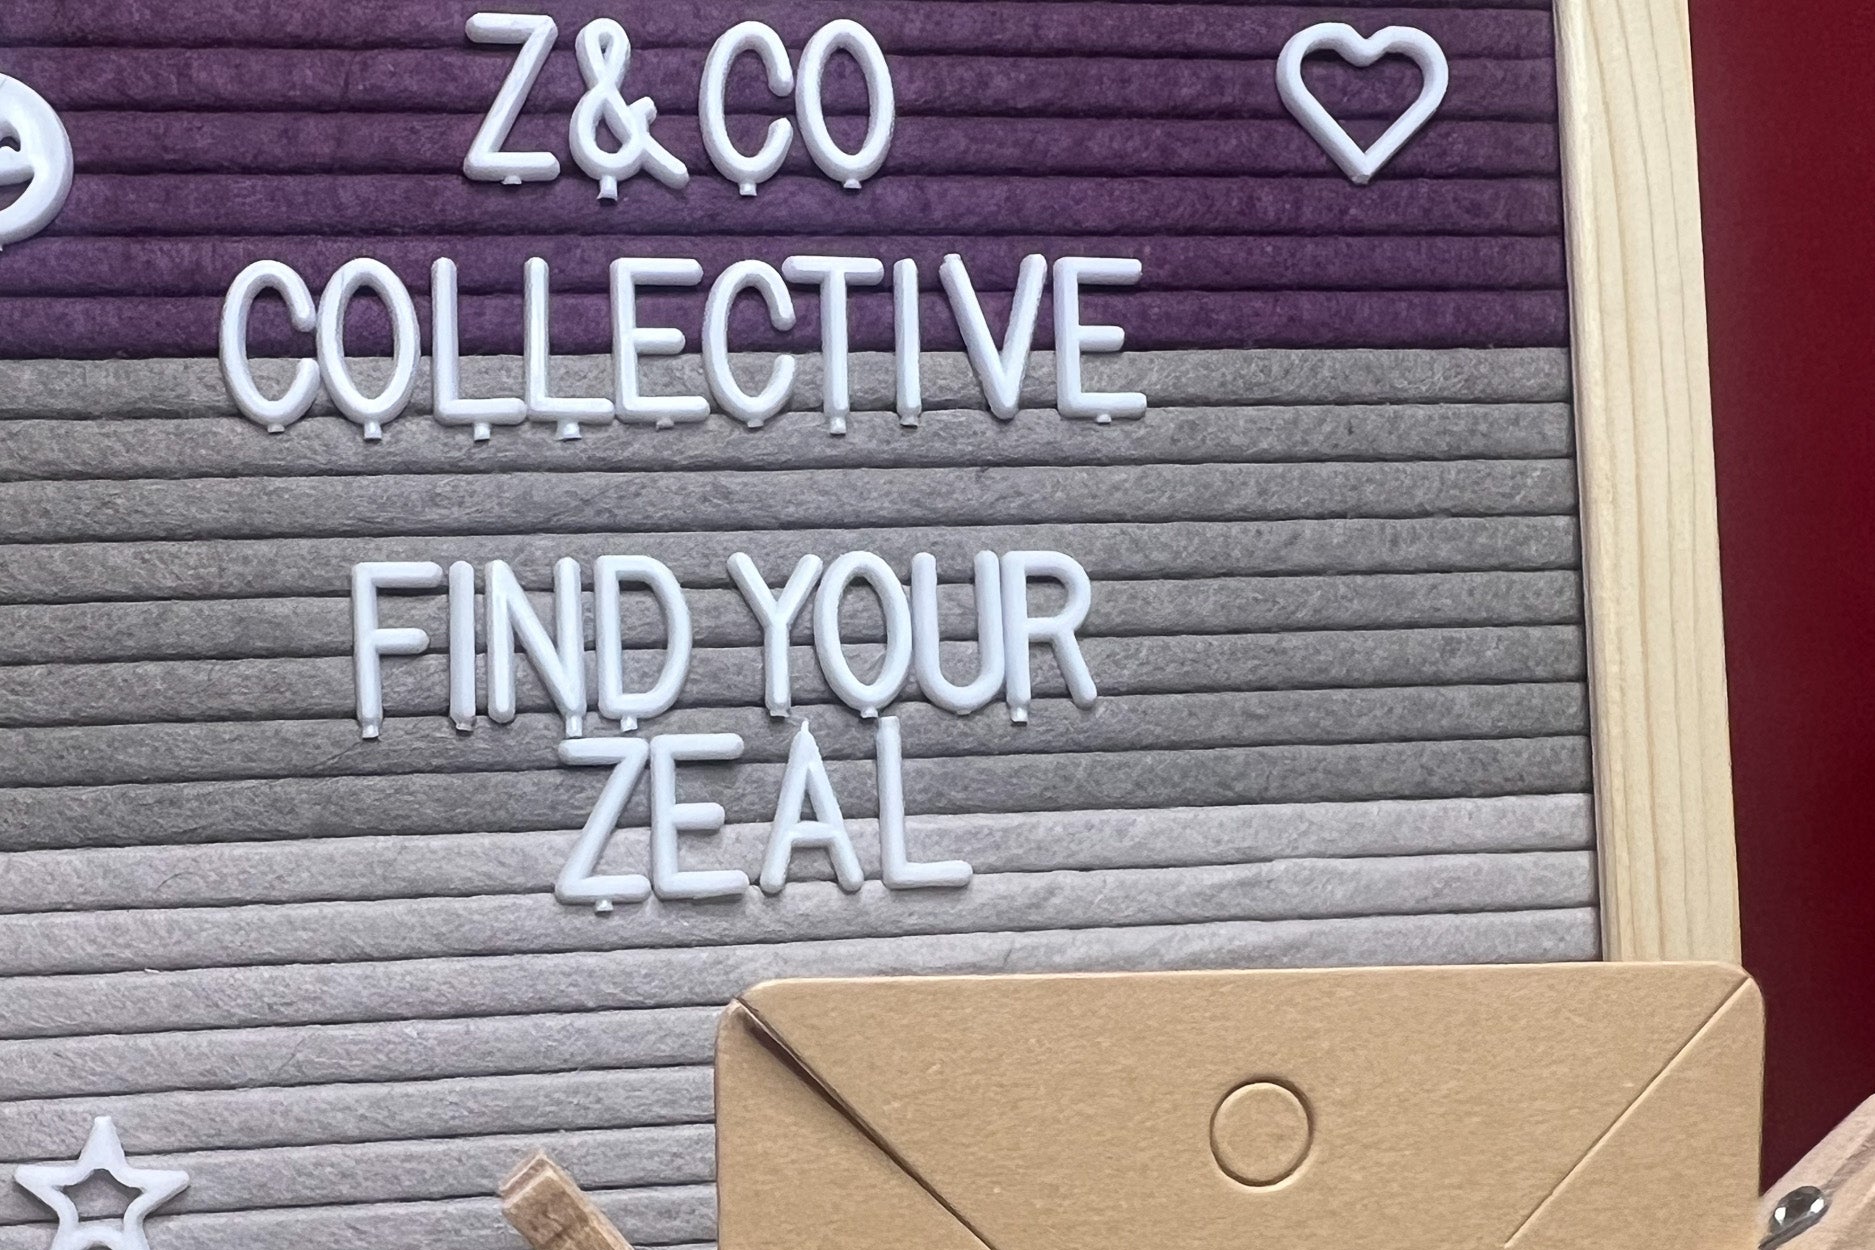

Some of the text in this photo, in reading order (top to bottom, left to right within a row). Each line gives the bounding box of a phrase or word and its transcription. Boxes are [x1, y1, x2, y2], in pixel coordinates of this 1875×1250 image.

[464, 12, 896, 198] Z&CO
[218, 253, 1147, 438] COLLECTIVE
[352, 550, 1098, 738] FIND YOUR
[554, 716, 973, 912] ZEAL
